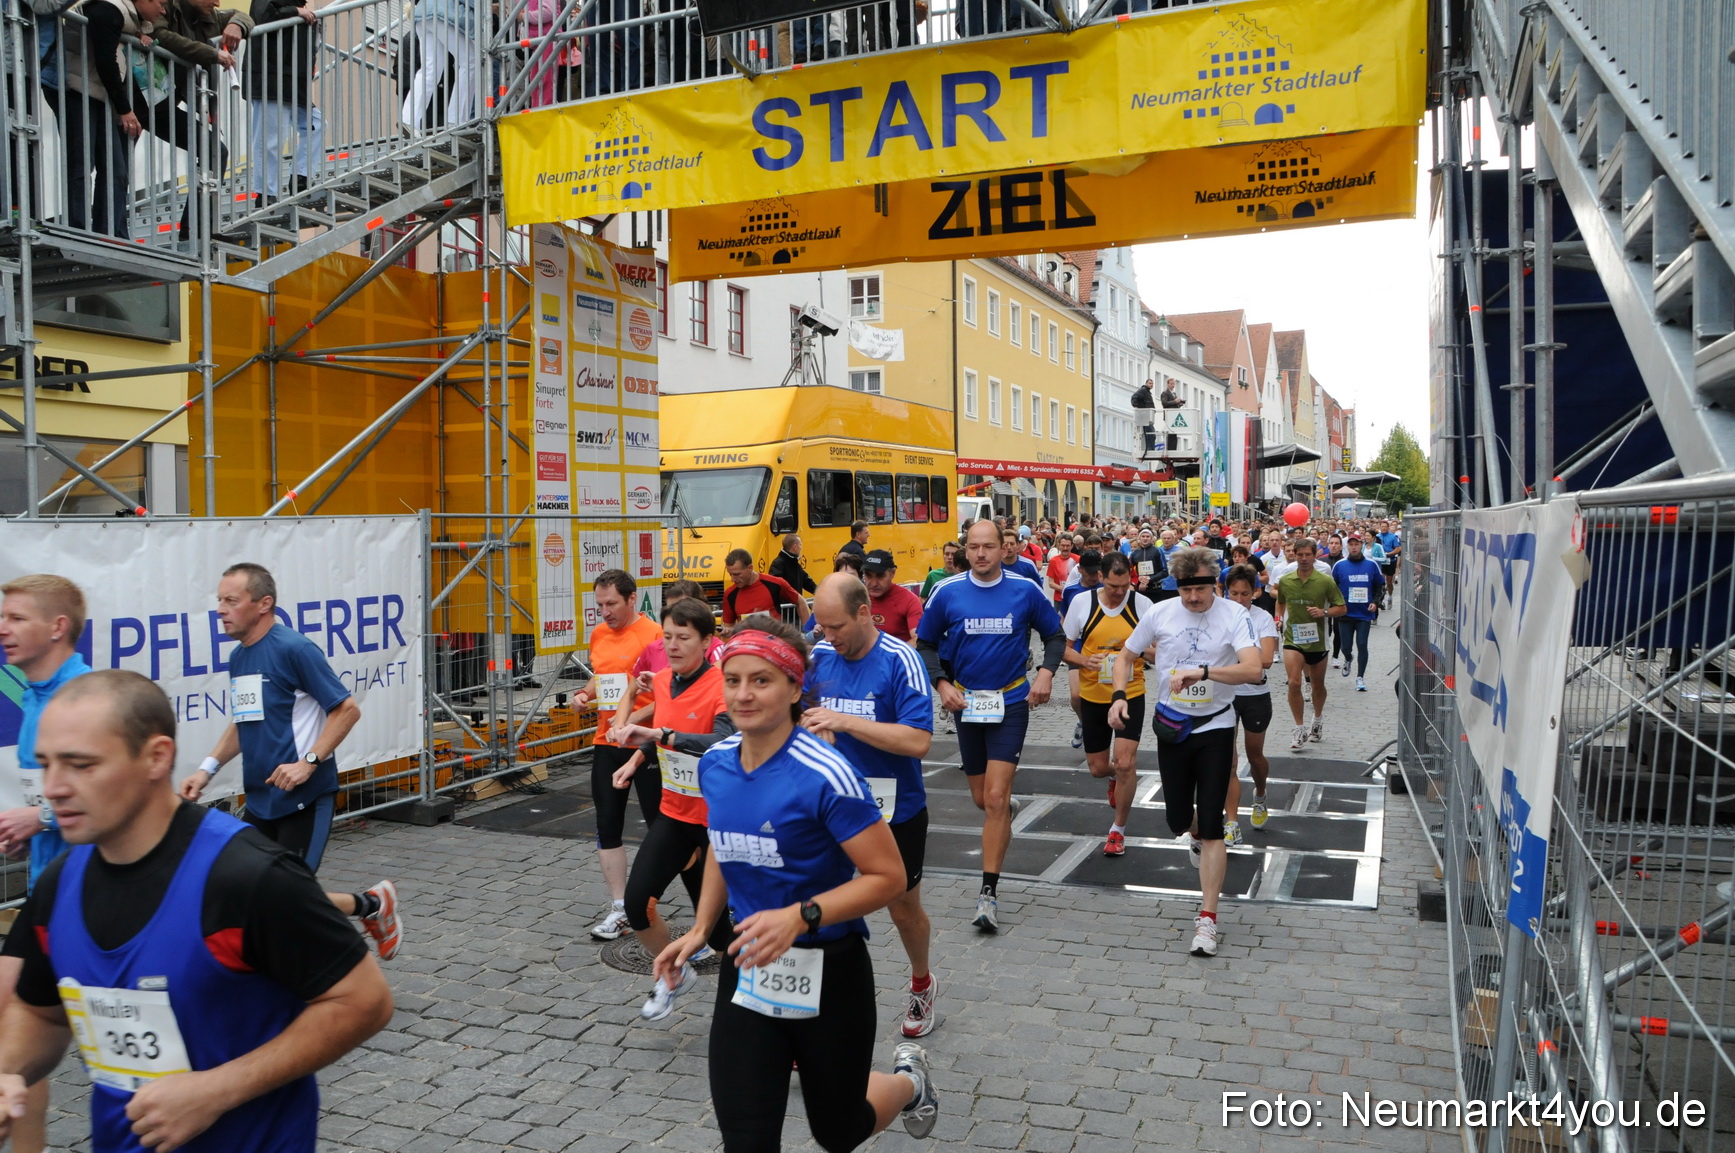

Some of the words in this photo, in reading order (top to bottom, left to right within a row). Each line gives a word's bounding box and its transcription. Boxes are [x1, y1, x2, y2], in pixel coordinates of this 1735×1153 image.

[1130, 78, 1255, 110] Neumarkter
[1261, 64, 1364, 94] Stadtlauf
[752, 59, 1069, 171] START
[535, 161, 624, 187] Neumarkter
[627, 151, 704, 174] Stadtlauf
[1194, 184, 1294, 205] Neumarkter
[1298, 170, 1377, 193] Stadtlauf
[928, 168, 1097, 240] ZIEL
[697, 232, 775, 251] Neumarkter
[778, 225, 842, 245] Stadtlauf
[615, 262, 657, 282] MERZ
[628, 326, 653, 336] WITTMANN
[536, 382, 566, 397] Sinupret
[624, 376, 658, 396] OBI
[536, 396, 554, 409] forte
[625, 431, 650, 446] MCM
[829, 446, 860, 457] SPORTRONIC
[694, 453, 749, 465] TIMING
[904, 455, 918, 464] EVENT
[918, 456, 934, 466] SERVICE
[970, 462, 993, 470] Service
[537, 502, 569, 510] HACKNER
[606, 497, 620, 505] BÖGL
[583, 541, 619, 557] Sinupret
[584, 560, 605, 572] forte
[544, 620, 573, 631] MERZ
[964, 618, 1013, 629] HUBER
[603, 688, 621, 699] 937
[1186, 686, 1206, 696] 199
[236, 693, 256, 705] 3503
[821, 696, 876, 715] HUBER
[975, 700, 1000, 711] 2554
[673, 767, 694, 783] 917
[760, 969, 811, 995] 2538
[106, 1030, 160, 1060] 363
